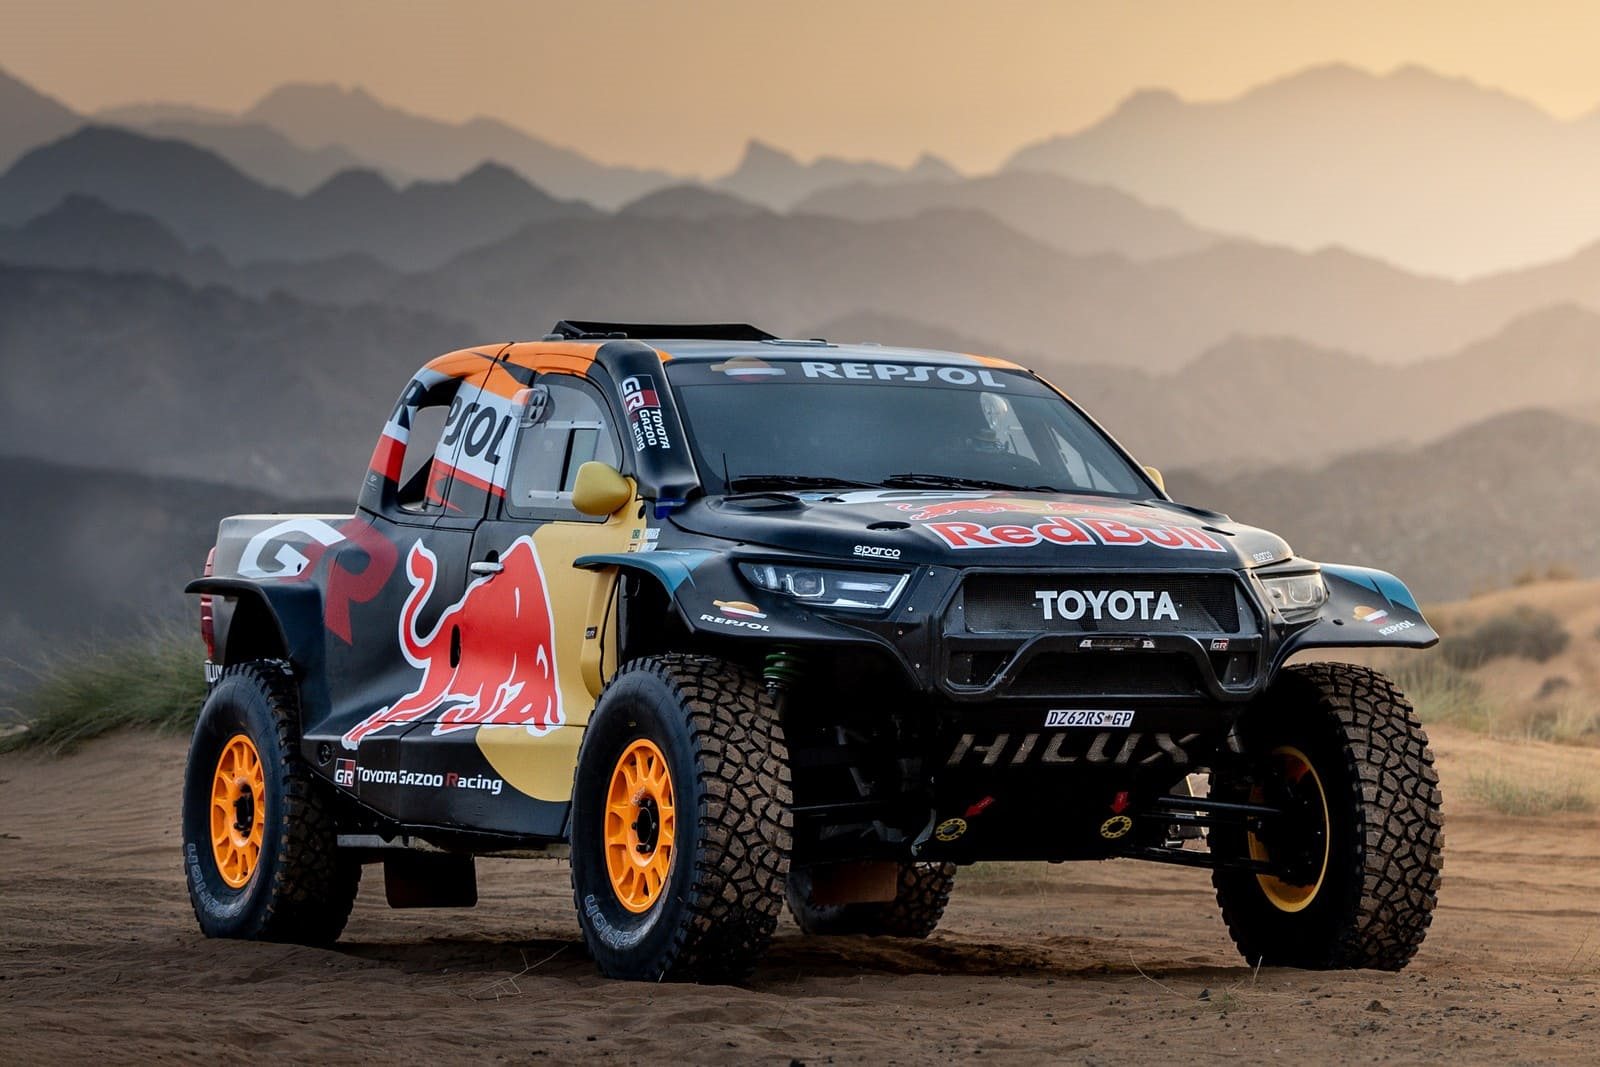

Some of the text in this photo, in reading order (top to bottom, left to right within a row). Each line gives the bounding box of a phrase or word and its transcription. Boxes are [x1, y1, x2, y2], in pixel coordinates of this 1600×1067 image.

[800, 361, 1006, 389] REPSOL
[621, 376, 645, 411] GR
[639, 409, 657, 446] GAZOO
[651, 409, 670, 449] TOYOTA
[923, 516, 1227, 553] Red Bull
[853, 544, 901, 558] sparco
[1035, 589, 1179, 621] TOYOTA
[700, 613, 770, 633] REPSOL
[1378, 619, 1415, 636] REPSOL
[1212, 640, 1228, 651] GR
[1047, 711, 1132, 727] DZ62RS GP
[947, 733, 1200, 765] HILUX
[335, 766, 504, 795] GR TOYOTA GAZOO Racing
